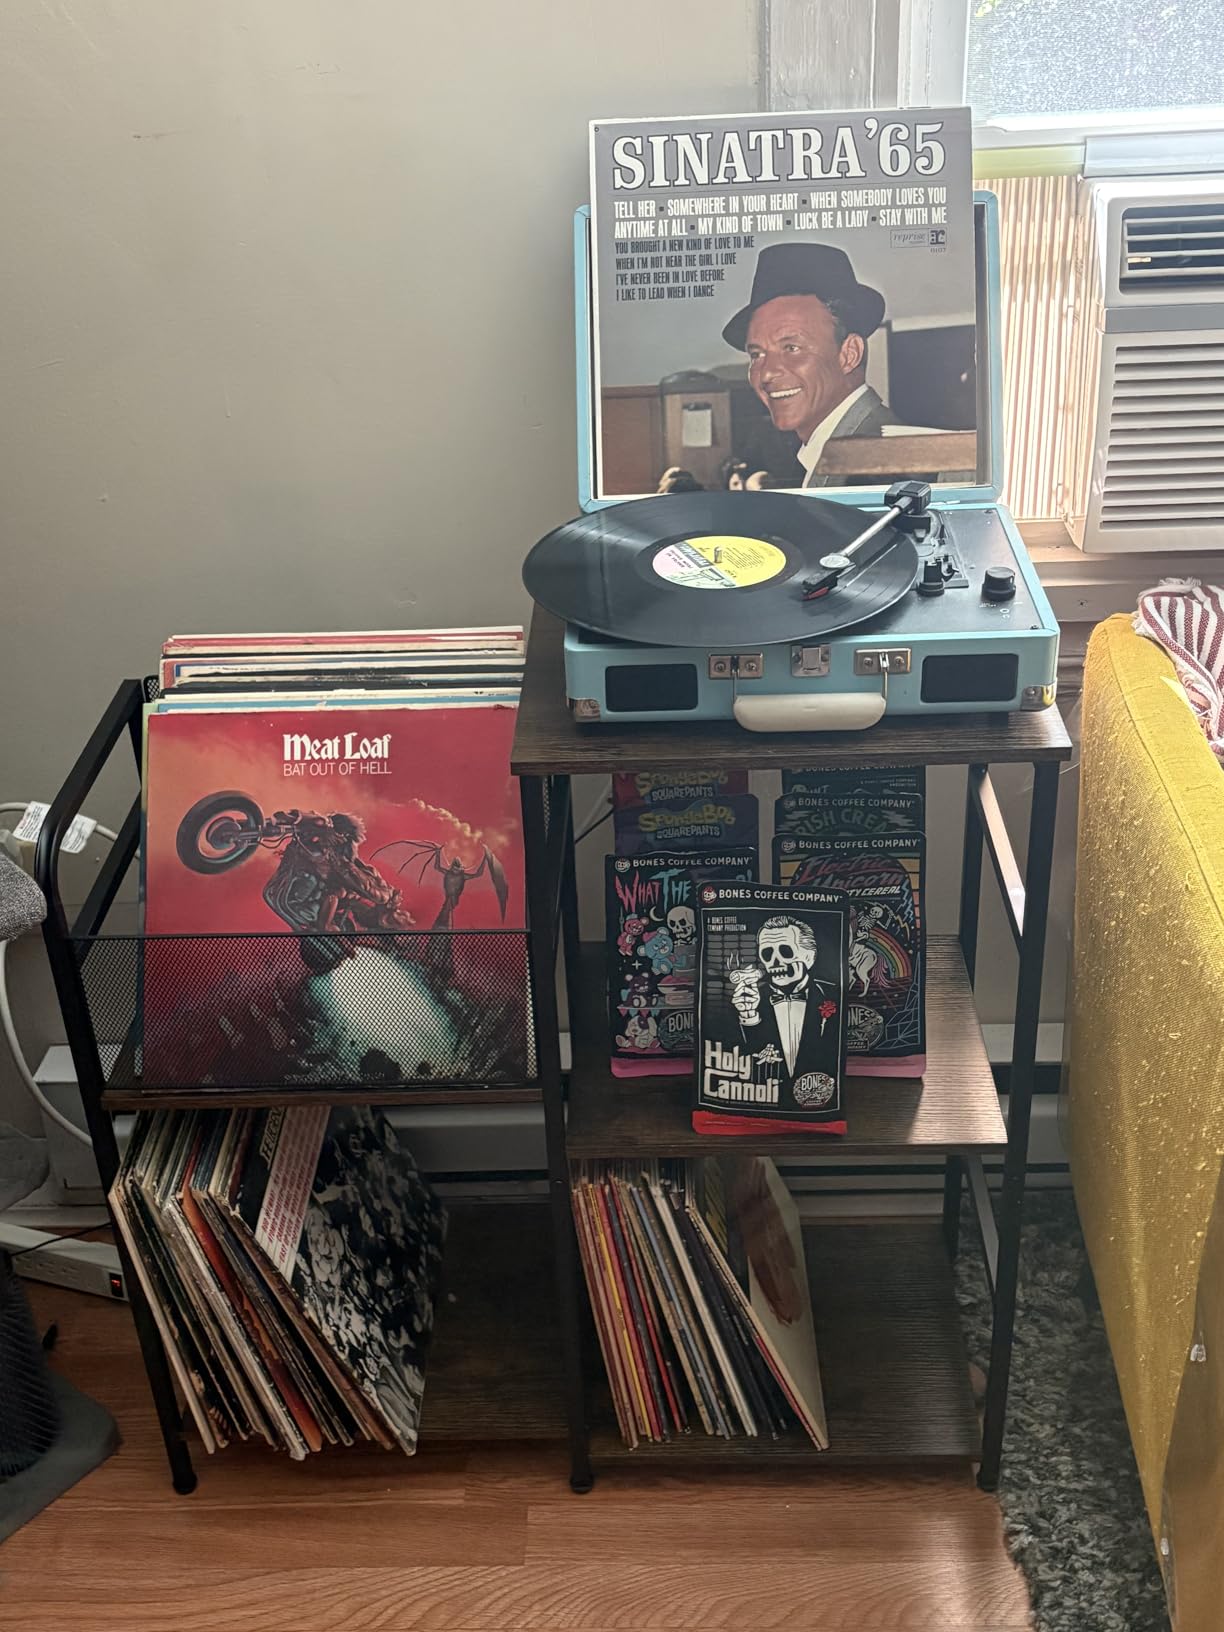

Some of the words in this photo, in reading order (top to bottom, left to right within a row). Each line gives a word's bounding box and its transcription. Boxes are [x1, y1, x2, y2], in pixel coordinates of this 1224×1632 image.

[614, 201, 635, 219] TELL
[638, 200, 656, 217] HER
[667, 197, 726, 216] SOMEWHERE
[729, 196, 739, 213] IN
[742, 195, 763, 212] YOUR
[770, 193, 798, 211] HEART
[810, 191, 837, 209] WHEN
[841, 188, 892, 208] SOMEBODY
[896, 187, 925, 205] LOVES
[927, 187, 947, 204] YOU
[614, 220, 655, 239] ANYTIME
[657, 219, 669, 237] AT
[671, 218, 688, 236] ALL
[697, 217, 713, 235] MY
[716, 216, 739, 234] KIND
[741, 215, 753, 232] OF
[756, 214, 783, 232] TOWN
[794, 212, 819, 230] LUCK
[821, 211, 834, 229] BE
[836, 210, 843, 228] A
[845, 209, 869, 227] LADY
[879, 208, 903, 227] STAY
[904, 207, 928, 225] WITH
[931, 206, 947, 224] ME
[615, 241, 628, 254] YOU
[631, 240, 660, 254] BROUGHT
[662, 240, 667, 252] A
[669, 239, 684, 252] NEW
[686, 238, 701, 251] KIND
[704, 237, 713, 250] OF
[714, 237, 731, 250] LOVE
[733, 236, 741, 249] TO
[743, 235, 755, 248] ME
[616, 257, 635, 270] WHEN
[637, 256, 648, 269] I'M
[650, 256, 663, 269] NOT
[665, 255, 682, 268] NEAR
[684, 254, 697, 267] THE
[699, 253, 714, 266] GIRL
[721, 252, 736, 265] LOVE
[616, 273, 628, 286] I'VE
[630, 272, 651, 285] NEVER
[653, 271, 670, 284] BEEN
[672, 270, 679, 283] IN
[682, 270, 698, 283] LOVE
[700, 269, 725, 282] BEFORE
[621, 288, 636, 301] LIKE
[638, 288, 646, 300] TO
[648, 286, 664, 300] LEAD
[667, 286, 686, 299] WHEN
[693, 285, 714, 298] DANCE
[283, 733, 340, 760] Meat
[344, 732, 392, 759] Loaf
[283, 763, 306, 776] BAT
[309, 762, 336, 776] OUT
[338, 762, 356, 775] OF
[360, 761, 392, 774] HELL
[798, 798, 829, 807] BONES
[832, 798, 865, 807] COFFEE
[868, 799, 912, 809] COMPANY
[799, 840, 832, 849] BONES
[834, 839, 869, 849] COFFEE
[872, 839, 918, 848] COMPANY
[632, 858, 666, 868] BONES
[667, 857, 703, 867] COFFEE
[705, 857, 750, 866] COMPANY
[615, 870, 661, 913] WHAT
[650, 868, 692, 914] THE
[718, 889, 751, 899] BONES
[754, 890, 790, 900] COFFEE
[792, 891, 840, 903] COMPANY
[861, 886, 902, 897] CEREAL
[704, 1039, 751, 1080] Holy
[703, 1068, 780, 1104] Cannoli
[801, 1075, 826, 1091] BONES
